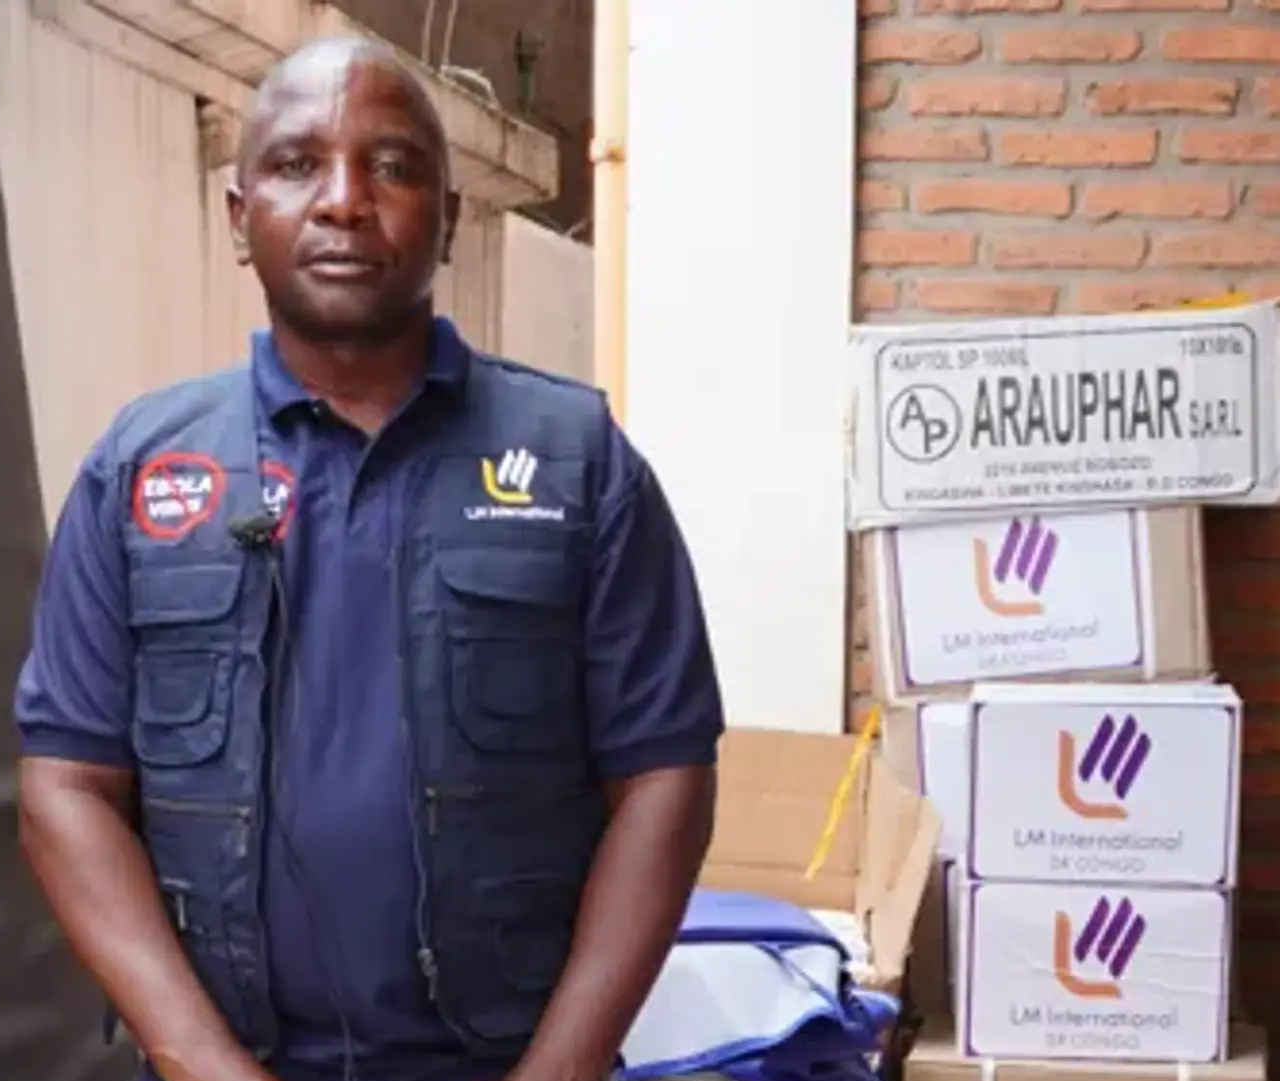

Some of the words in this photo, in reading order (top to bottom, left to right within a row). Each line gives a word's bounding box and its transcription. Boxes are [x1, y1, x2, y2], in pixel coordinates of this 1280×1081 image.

[970, 367, 1183, 450] ARAUPHAR
[940, 631, 972, 653] LM
[976, 617, 1099, 648] International
[1013, 830, 1047, 849] LM
[1051, 829, 1184, 853] International
[1009, 1007, 1042, 1027] LM
[1046, 1006, 1179, 1030] International
